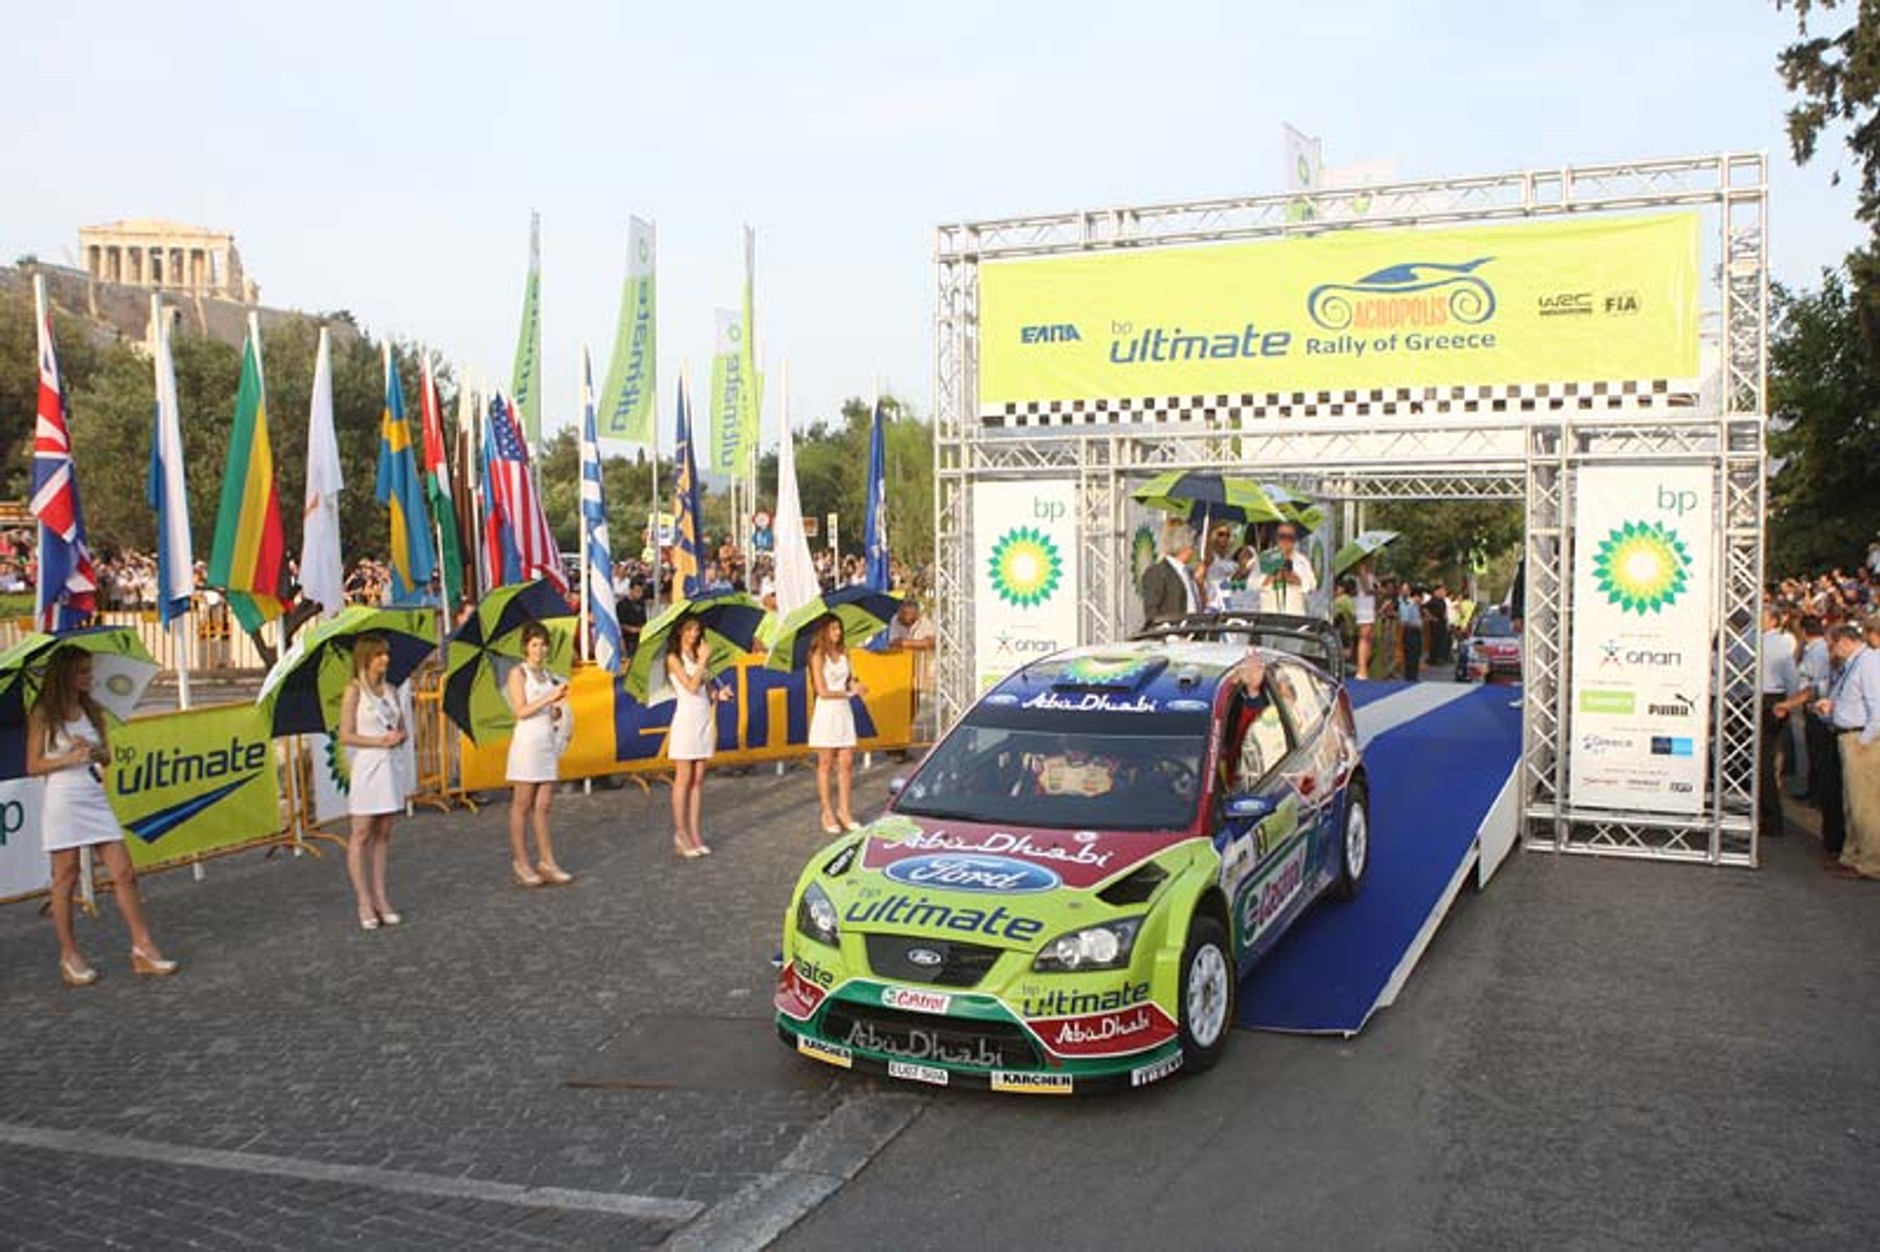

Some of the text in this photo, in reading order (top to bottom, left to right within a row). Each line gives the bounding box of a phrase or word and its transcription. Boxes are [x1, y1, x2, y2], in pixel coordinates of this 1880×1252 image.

[1354, 297, 1448, 328] ACROPOLIS
[1605, 296, 1637, 312] FIA
[1109, 323, 1291, 363] ultimate
[1111, 320, 1132, 335] bp
[1306, 332, 1496, 357] Rally of Greece
[1034, 496, 1066, 523] bp
[1657, 484, 1697, 515] bp
[114, 746, 135, 764] bp
[117, 736, 266, 796] ultimate
[0, 800, 24, 846] p
[910, 859, 1028, 890] Ford
[845, 894, 1043, 942] ultimate
[898, 988, 945, 1011] Castrol
[1023, 981, 1149, 1017] ultimate
